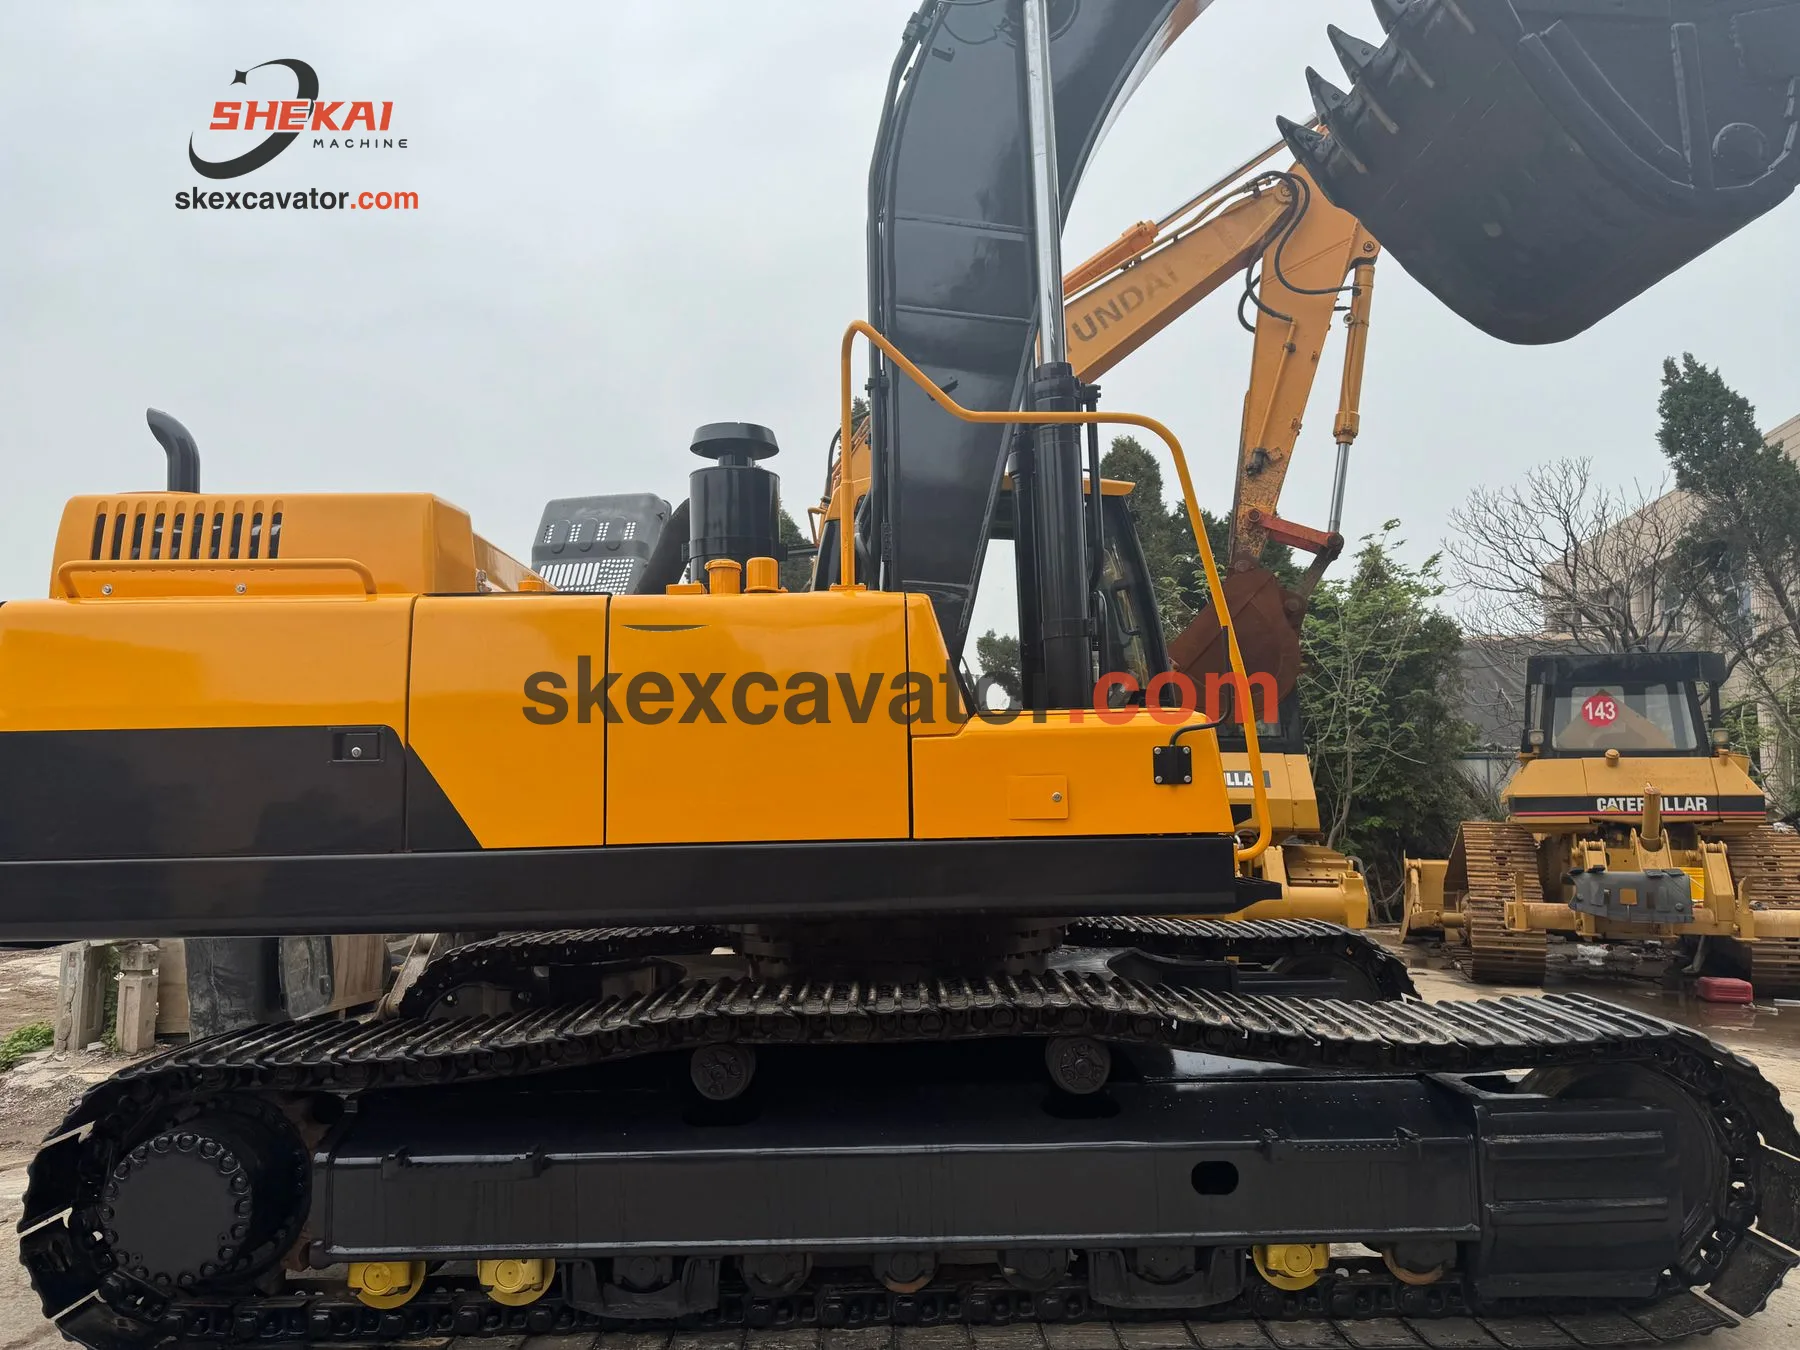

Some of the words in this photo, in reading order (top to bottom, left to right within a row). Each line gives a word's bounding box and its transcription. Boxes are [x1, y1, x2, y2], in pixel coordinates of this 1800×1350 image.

[1067, 263, 1180, 350] UNDAI
[1584, 701, 1616, 720] 143
[1596, 796, 1708, 812] CATERILLAR
